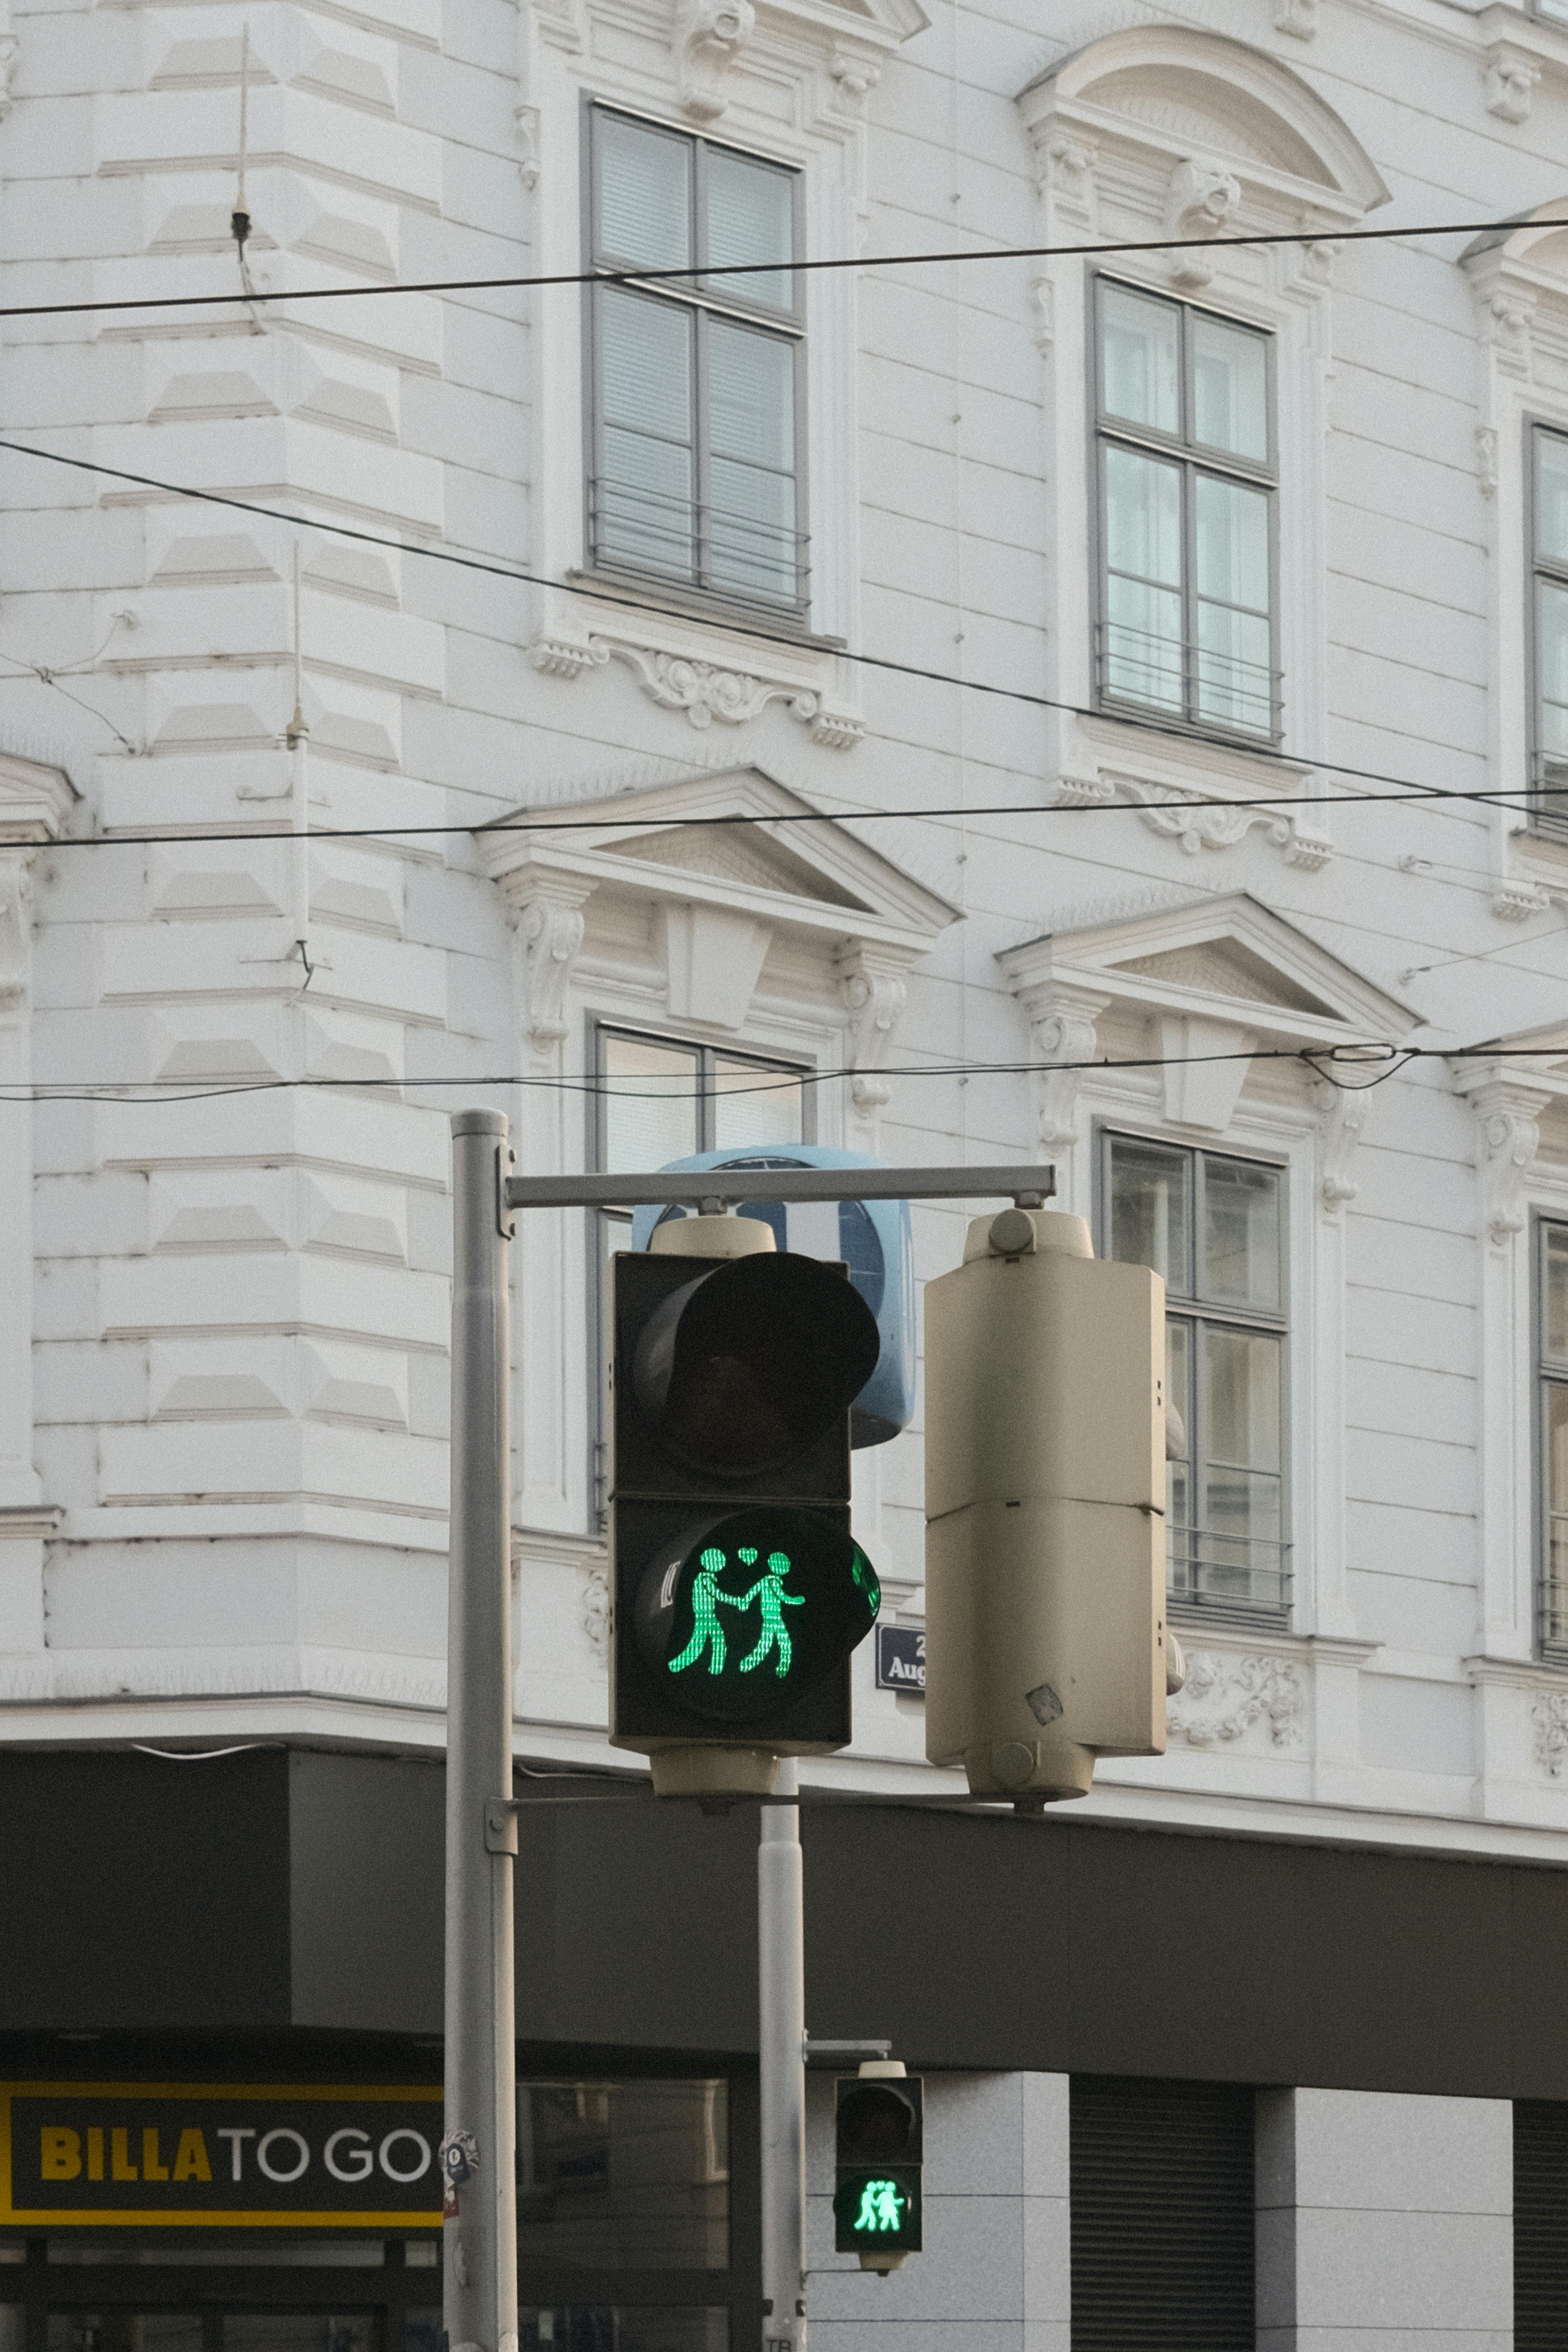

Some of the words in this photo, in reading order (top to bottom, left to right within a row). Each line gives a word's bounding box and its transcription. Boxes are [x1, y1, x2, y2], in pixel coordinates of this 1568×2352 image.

[41, 2128, 212, 2181] BILLA
[218, 2129, 309, 2182] TO
[323, 2129, 432, 2182] GO
